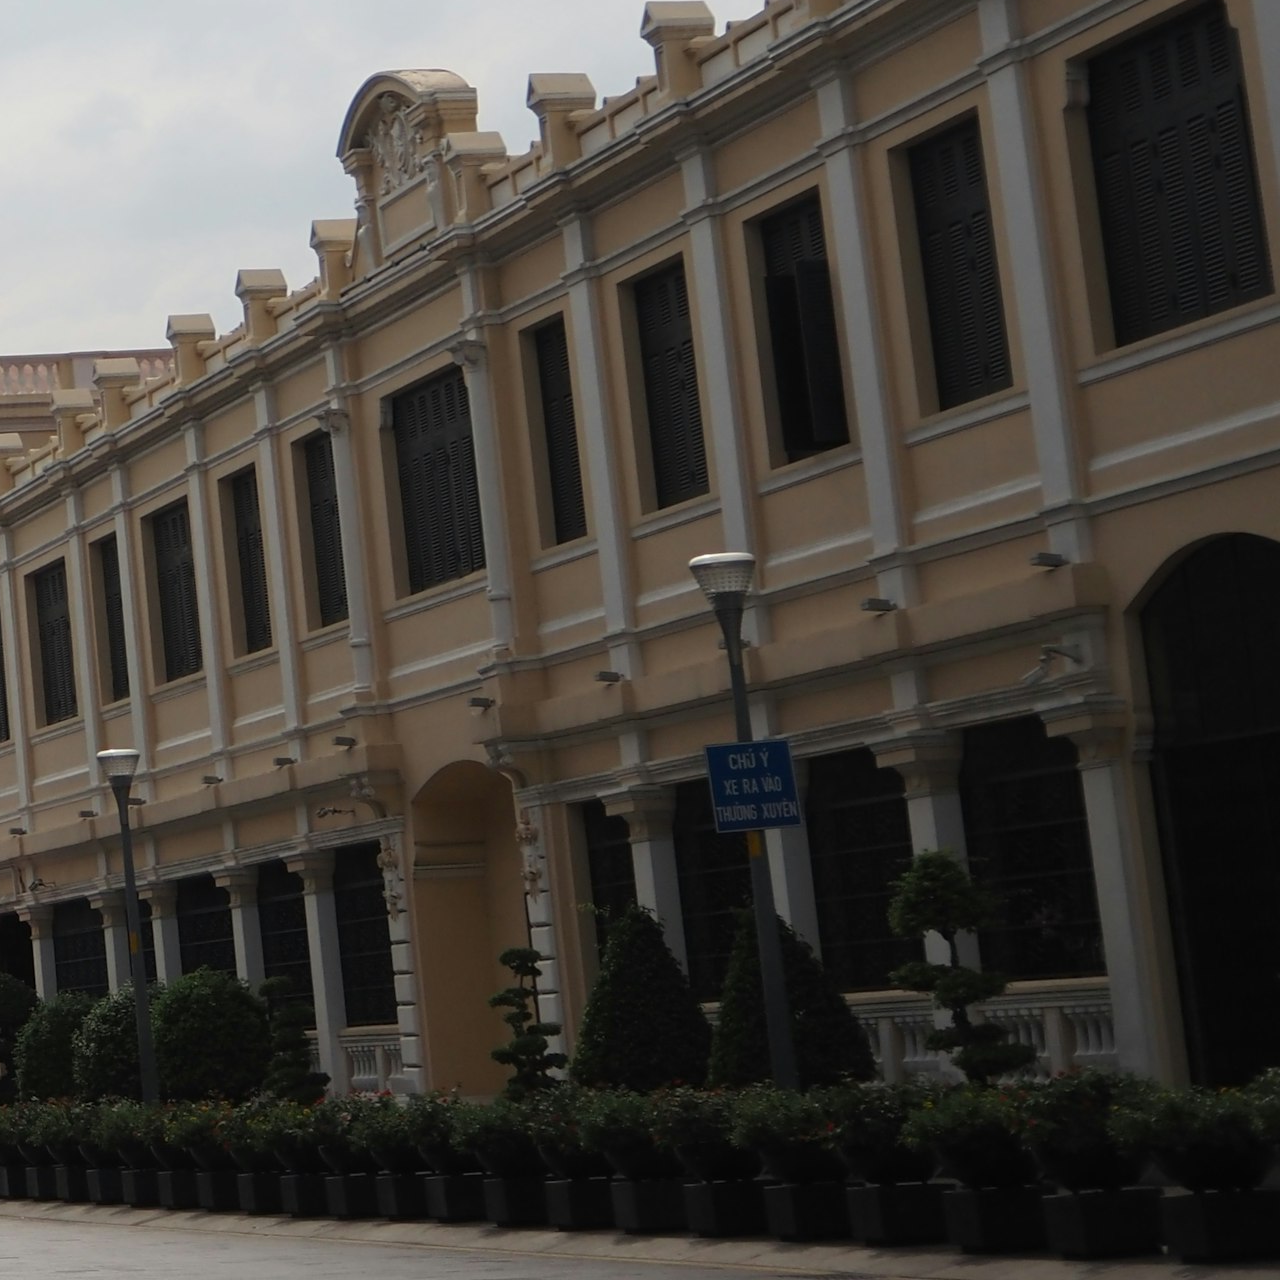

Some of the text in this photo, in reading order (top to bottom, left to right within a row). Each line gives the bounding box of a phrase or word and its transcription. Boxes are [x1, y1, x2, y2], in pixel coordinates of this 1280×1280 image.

[728, 747, 769, 770] CHÚ Ý
[723, 773, 782, 796] XE RA VÀO
